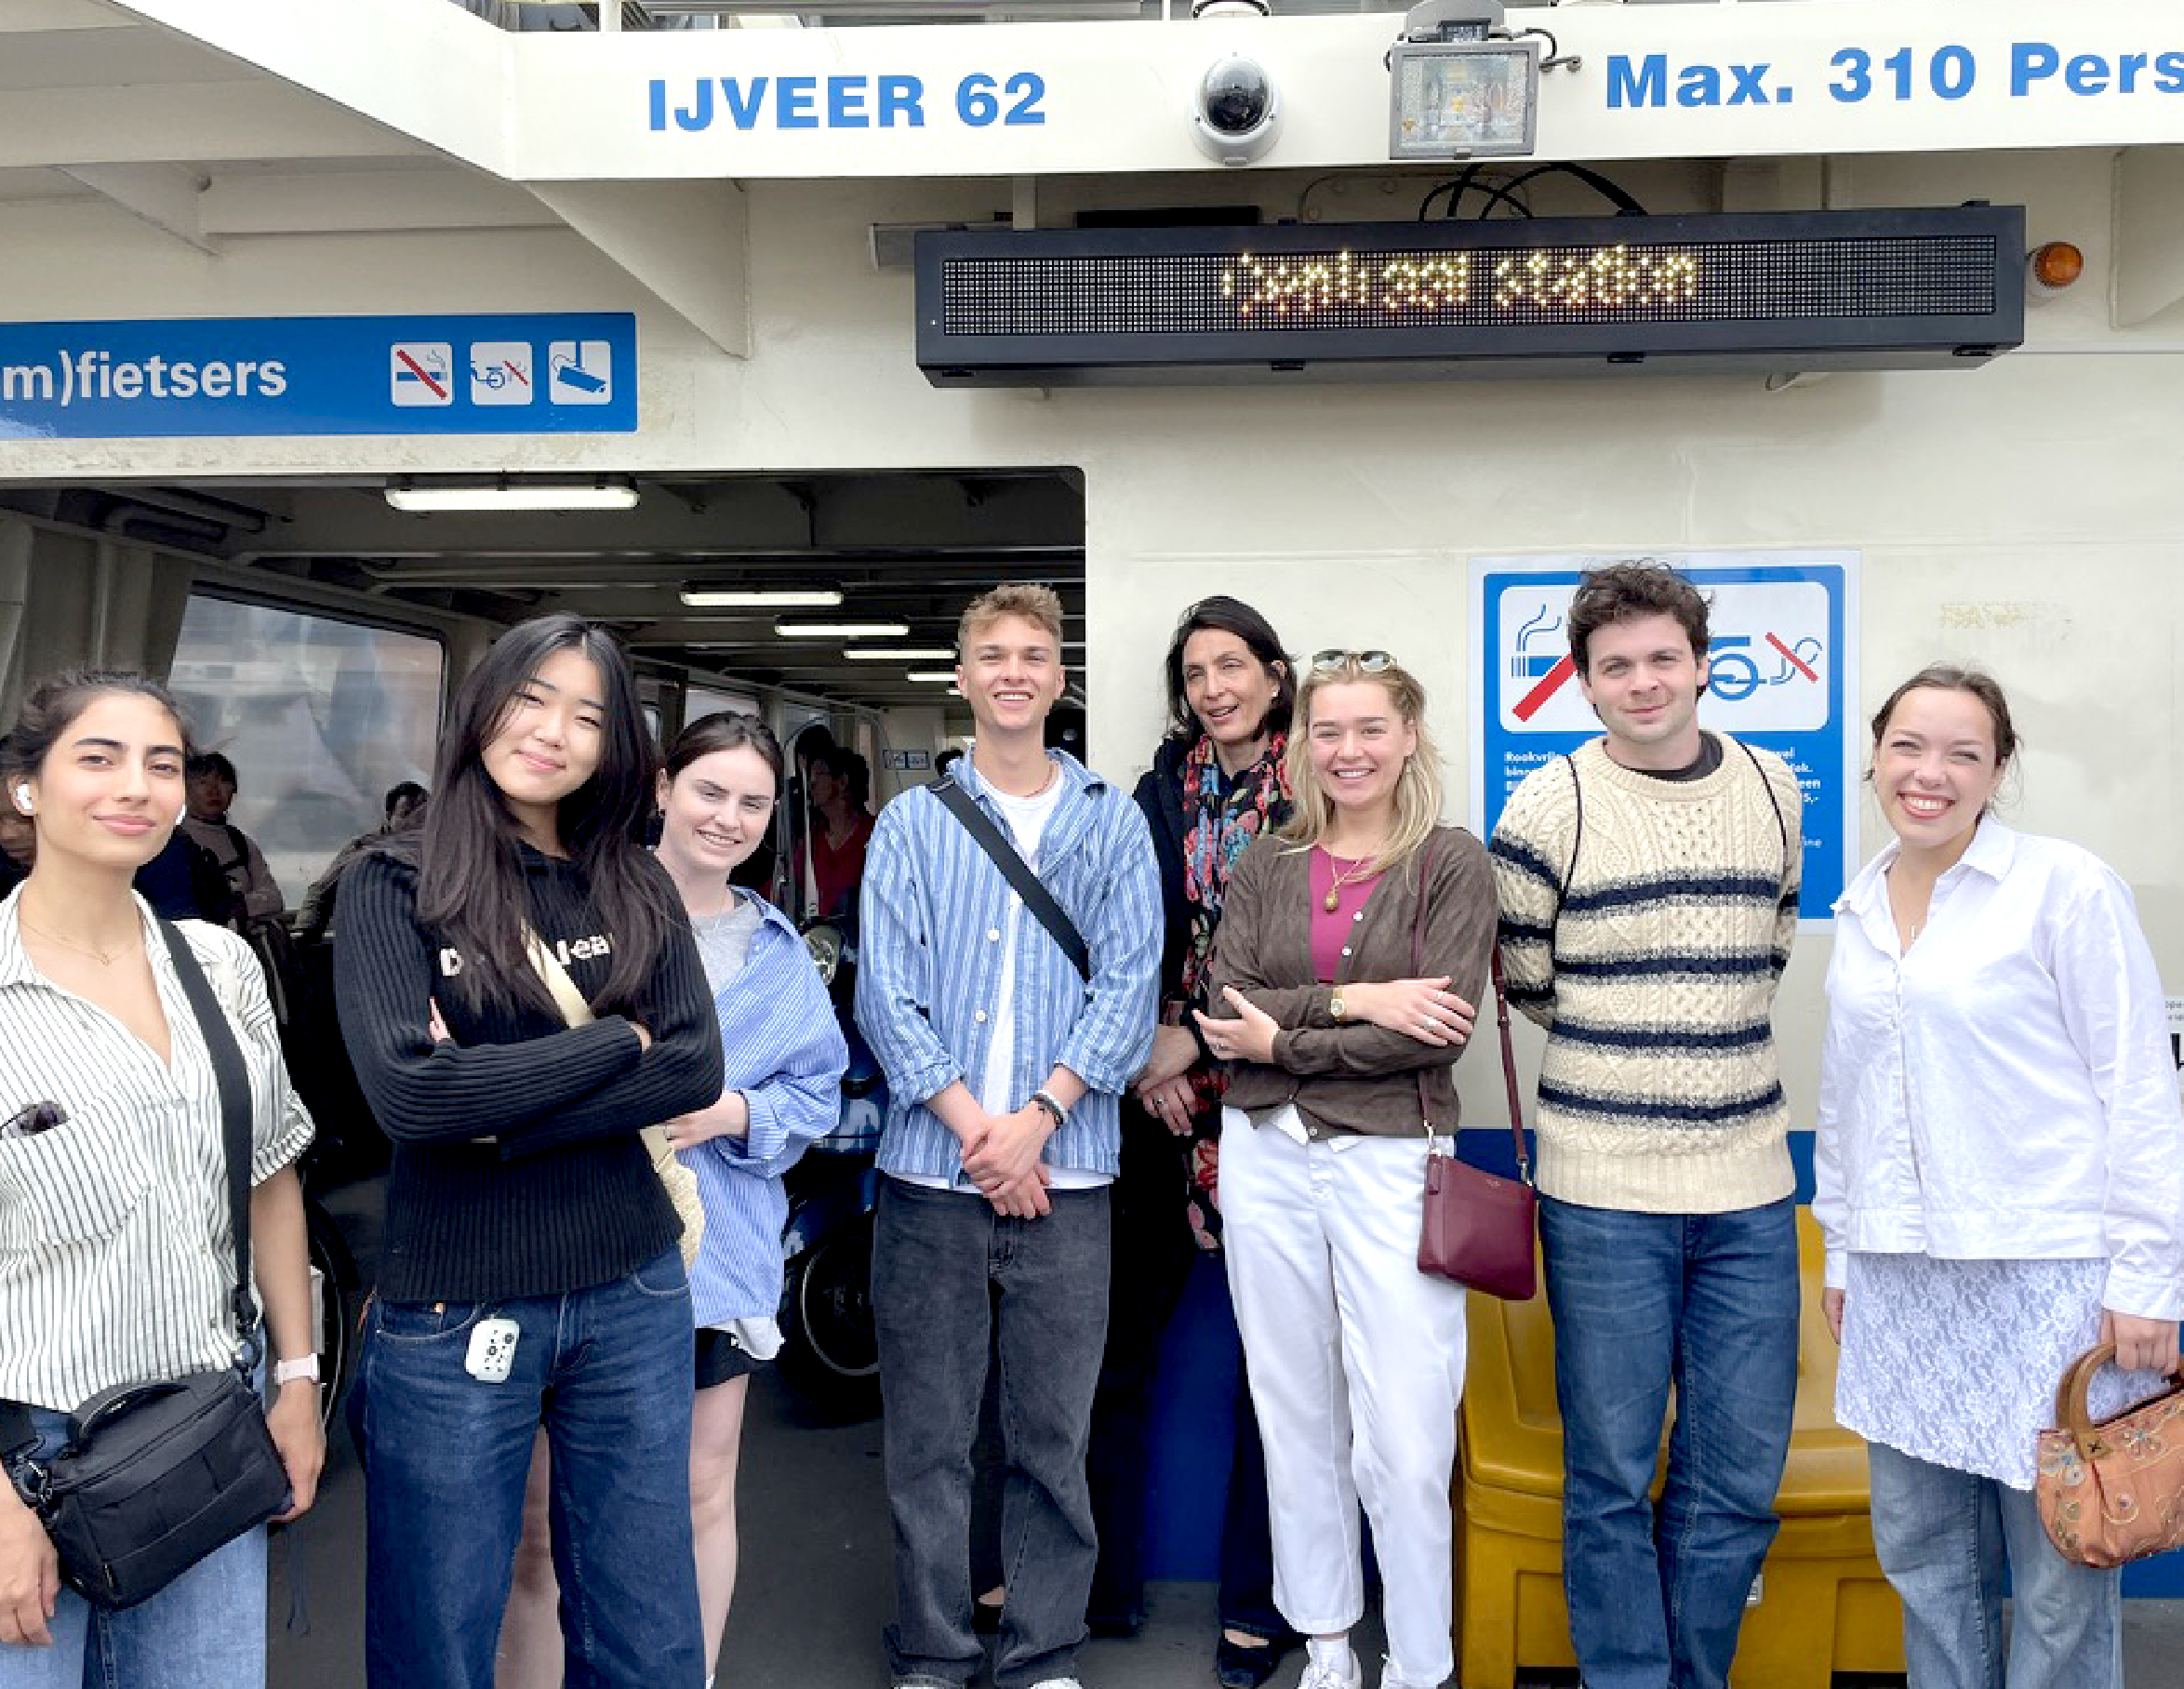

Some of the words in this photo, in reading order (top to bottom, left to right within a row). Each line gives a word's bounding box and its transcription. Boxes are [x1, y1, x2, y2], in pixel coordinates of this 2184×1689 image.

[648, 74, 926, 132] IJVEER
[955, 71, 1045, 127] 62
[1606, 53, 1793, 109] Max.
[1828, 44, 1977, 102] 310
